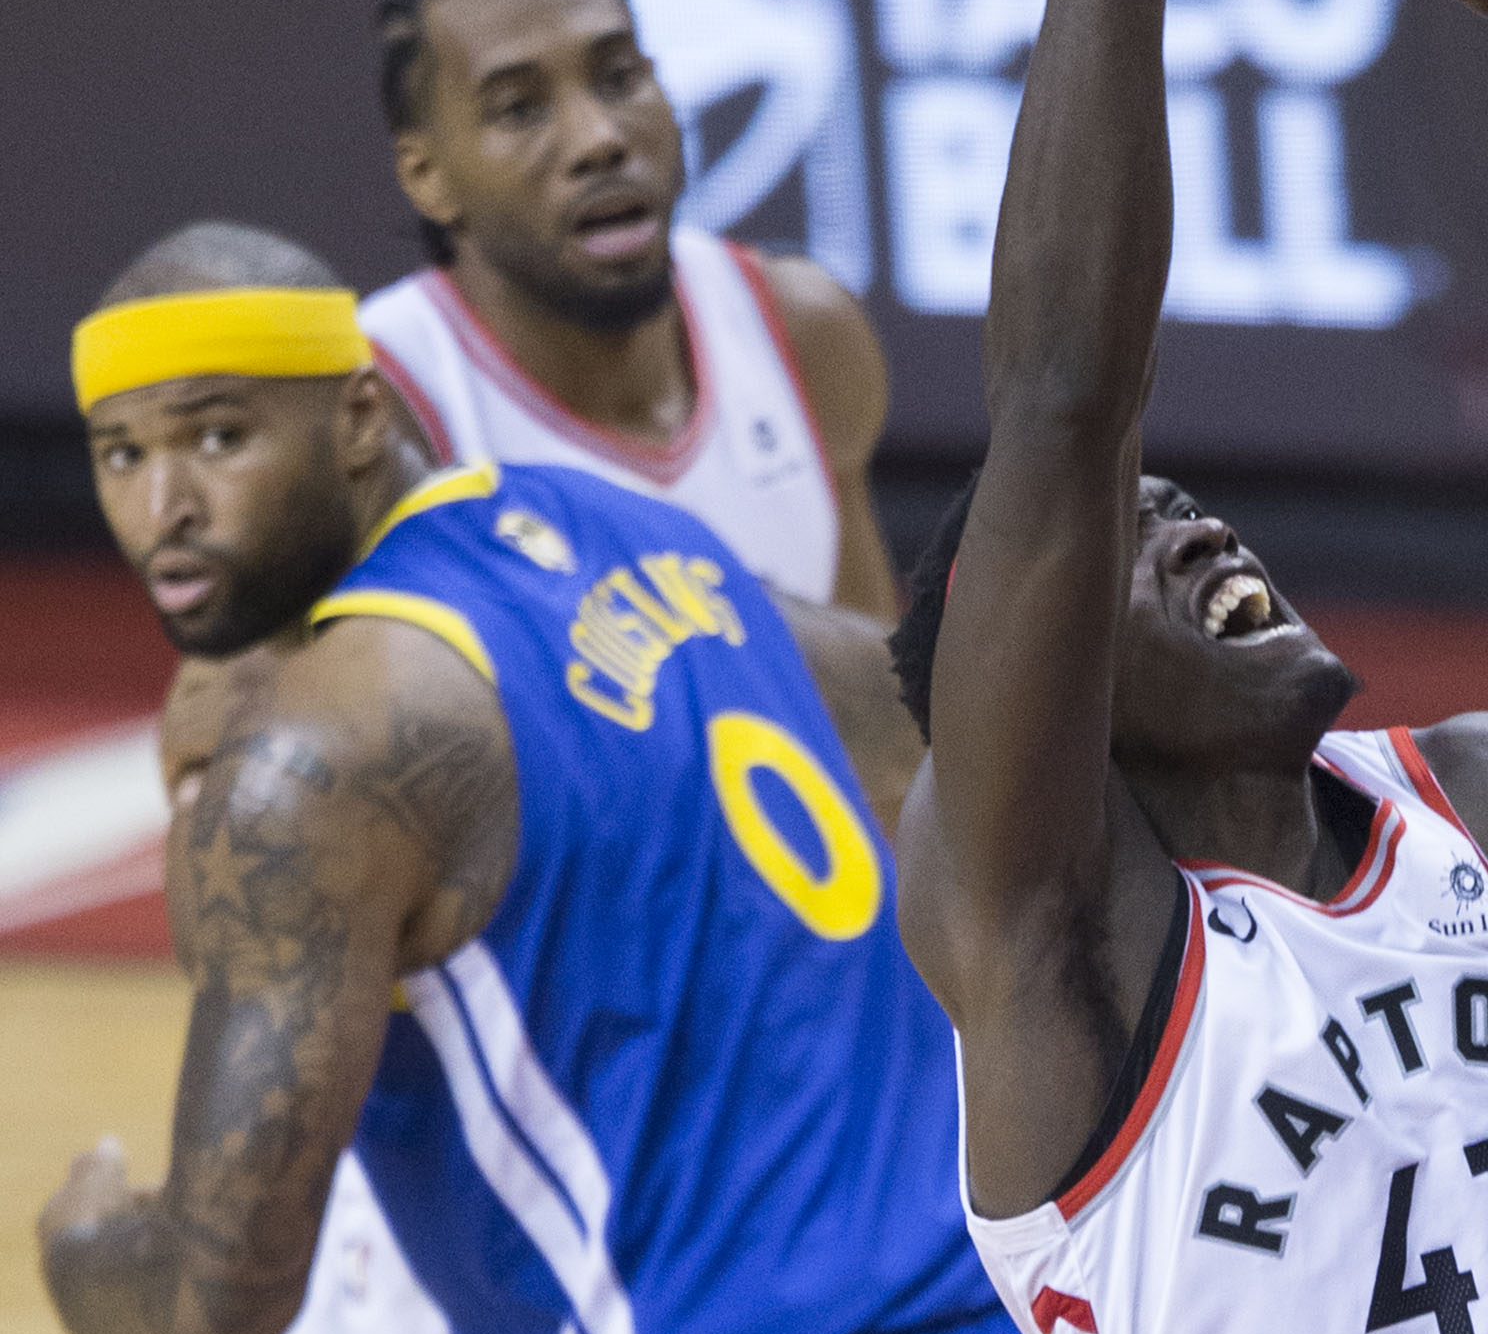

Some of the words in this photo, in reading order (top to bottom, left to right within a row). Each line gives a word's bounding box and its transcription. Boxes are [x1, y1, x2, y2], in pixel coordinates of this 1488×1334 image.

[882, 72, 1412, 329] BLL
[707, 710, 882, 942] 0
[1428, 918, 1474, 936] Sun
